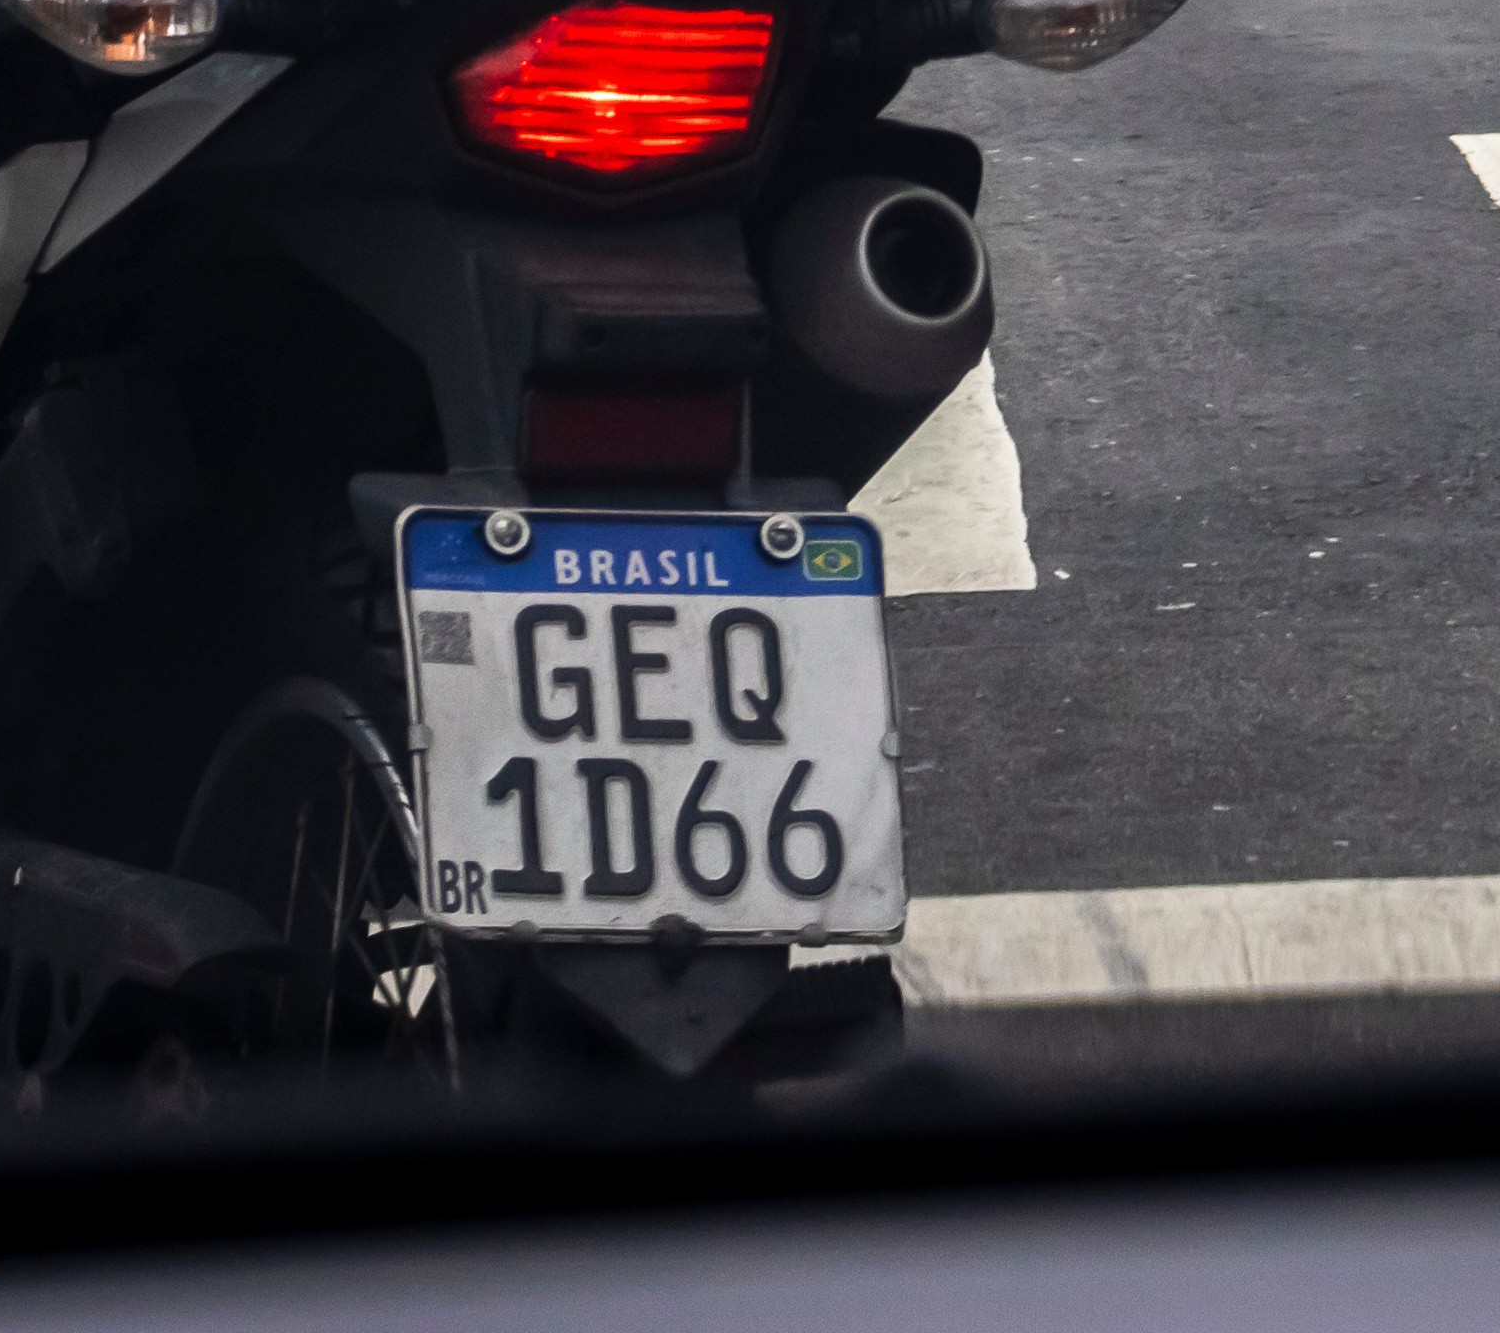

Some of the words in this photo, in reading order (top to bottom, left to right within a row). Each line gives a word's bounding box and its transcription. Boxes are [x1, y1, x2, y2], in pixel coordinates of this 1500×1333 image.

[555, 548, 731, 588] BRASIL
[514, 603, 786, 745] GEQ
[486, 756, 844, 900] 1D66
[436, 859, 489, 917] BR
